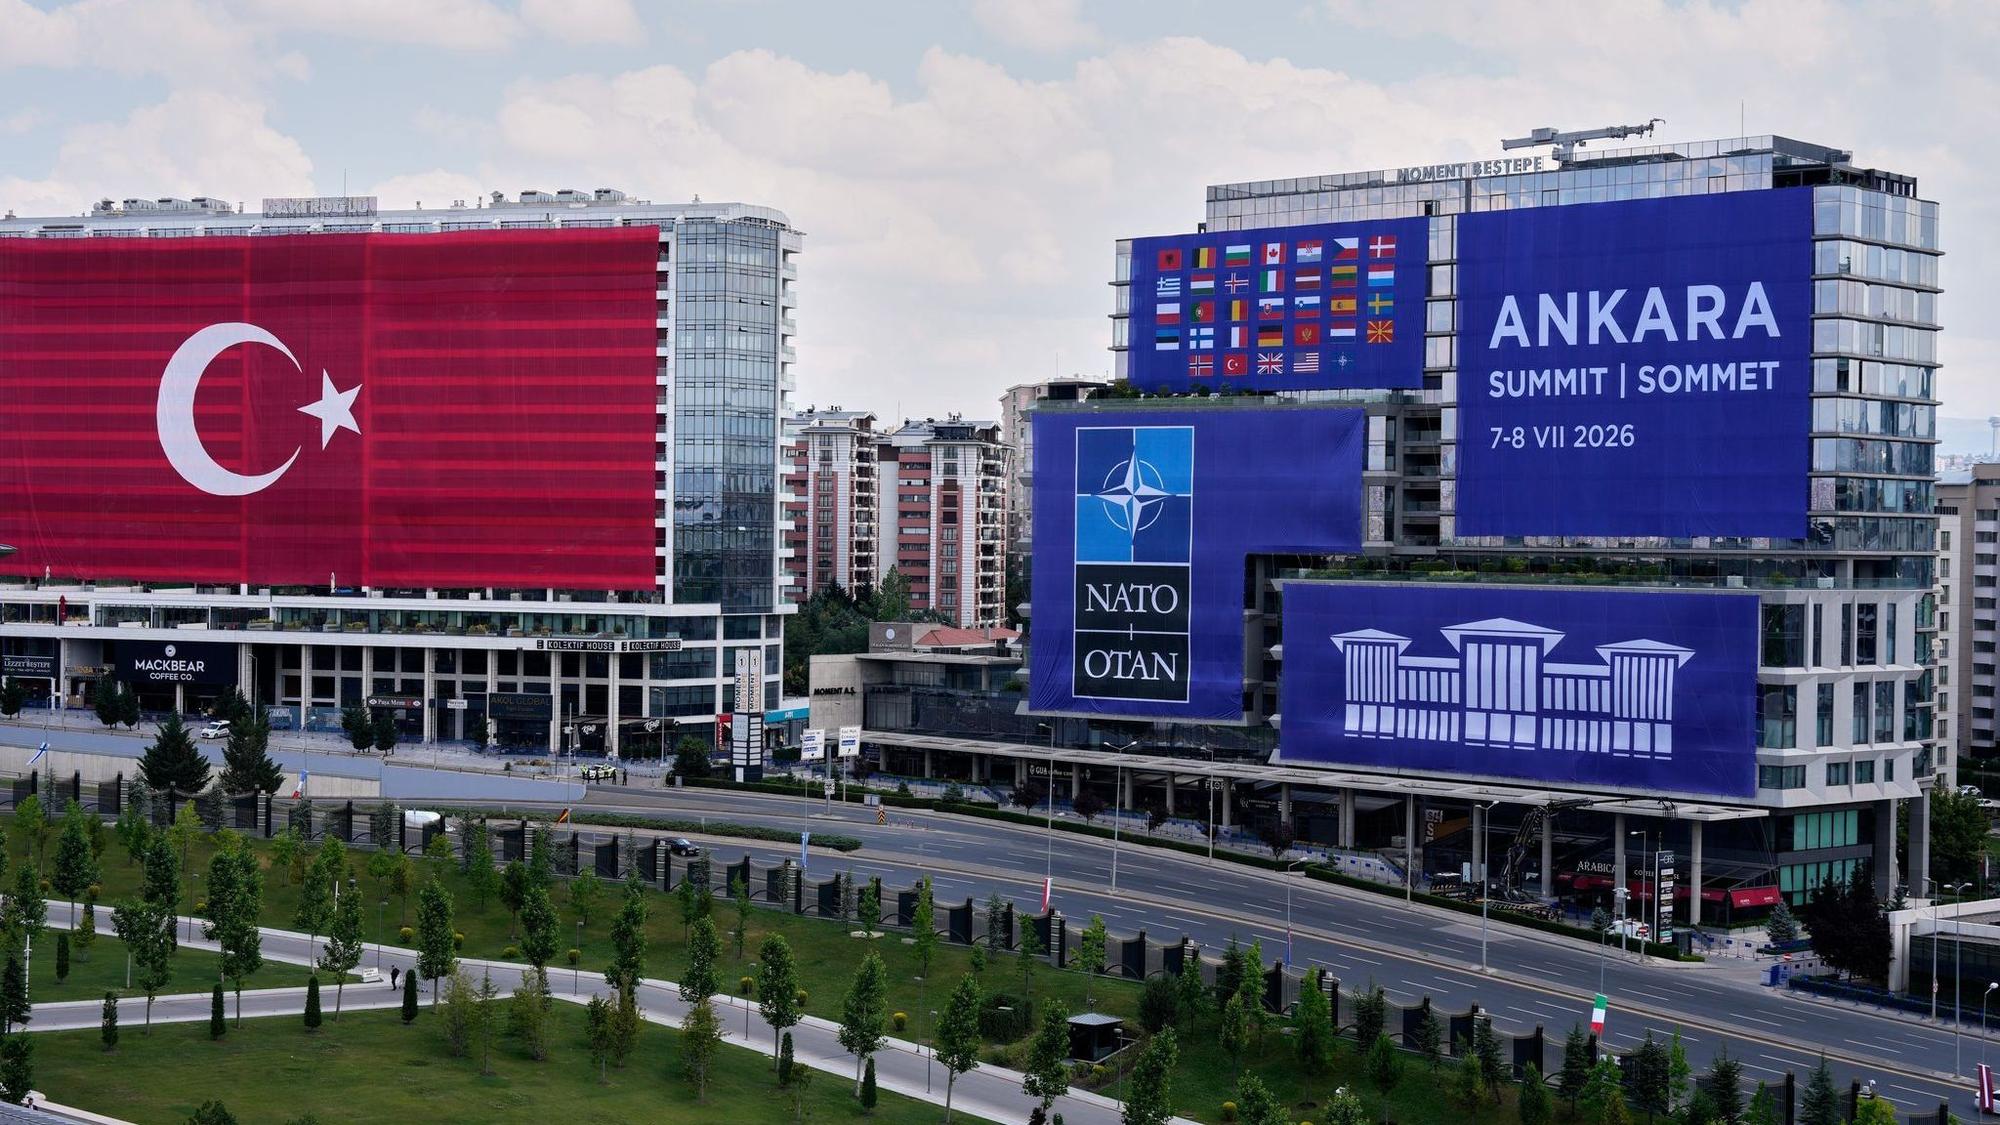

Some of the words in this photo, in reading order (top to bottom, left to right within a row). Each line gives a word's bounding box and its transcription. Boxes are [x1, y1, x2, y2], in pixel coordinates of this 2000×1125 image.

[1397, 163, 1466, 183] MOMENT
[1489, 281, 1781, 349] ANKARA
[1489, 367, 1608, 398] SUMMIT
[1638, 361, 1780, 394] SOMMET
[1490, 427, 1525, 449] 7-8
[1533, 426, 1565, 448] VII
[1573, 424, 1635, 447] 2026
[1085, 583, 1179, 614] NATO
[586, 641, 613, 650] HOUSE
[660, 641, 681, 649] HOUSE
[135, 659, 205, 672] MACKBEAR
[1084, 649, 1178, 682] OTAN
[149, 672, 179, 680] COFFEE
[180, 673, 195, 681] CO.
[813, 687, 842, 696] MOMENT
[516, 696, 551, 706] GLOBAL
[1035, 766, 1048, 775] GUA
